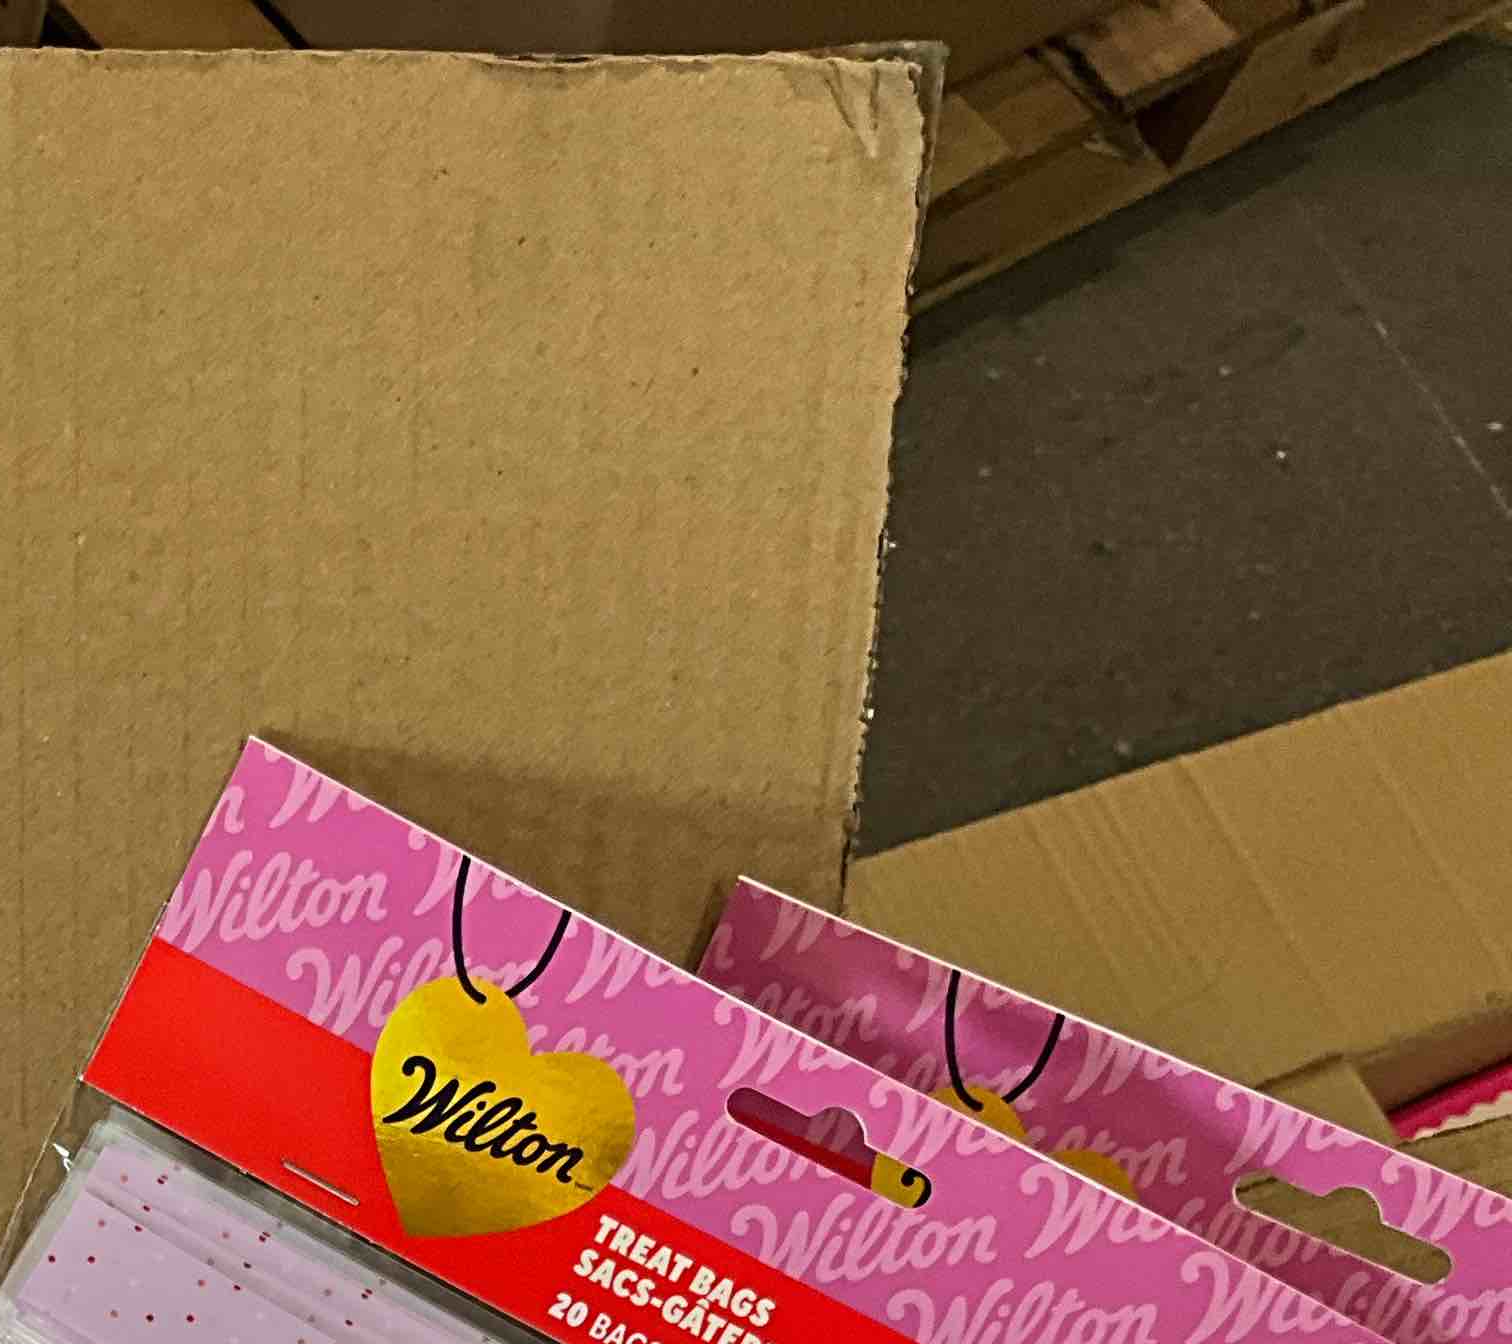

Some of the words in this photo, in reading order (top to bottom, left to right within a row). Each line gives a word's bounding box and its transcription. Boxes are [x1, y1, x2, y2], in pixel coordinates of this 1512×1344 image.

[154, 850, 386, 953] Wilton
[383, 1055, 583, 1183] Wilton
[594, 1214, 693, 1282] TREAT
[688, 1266, 776, 1326] BAGS
[731, 1204, 996, 1283] Wilton
[548, 1292, 588, 1327] 20
